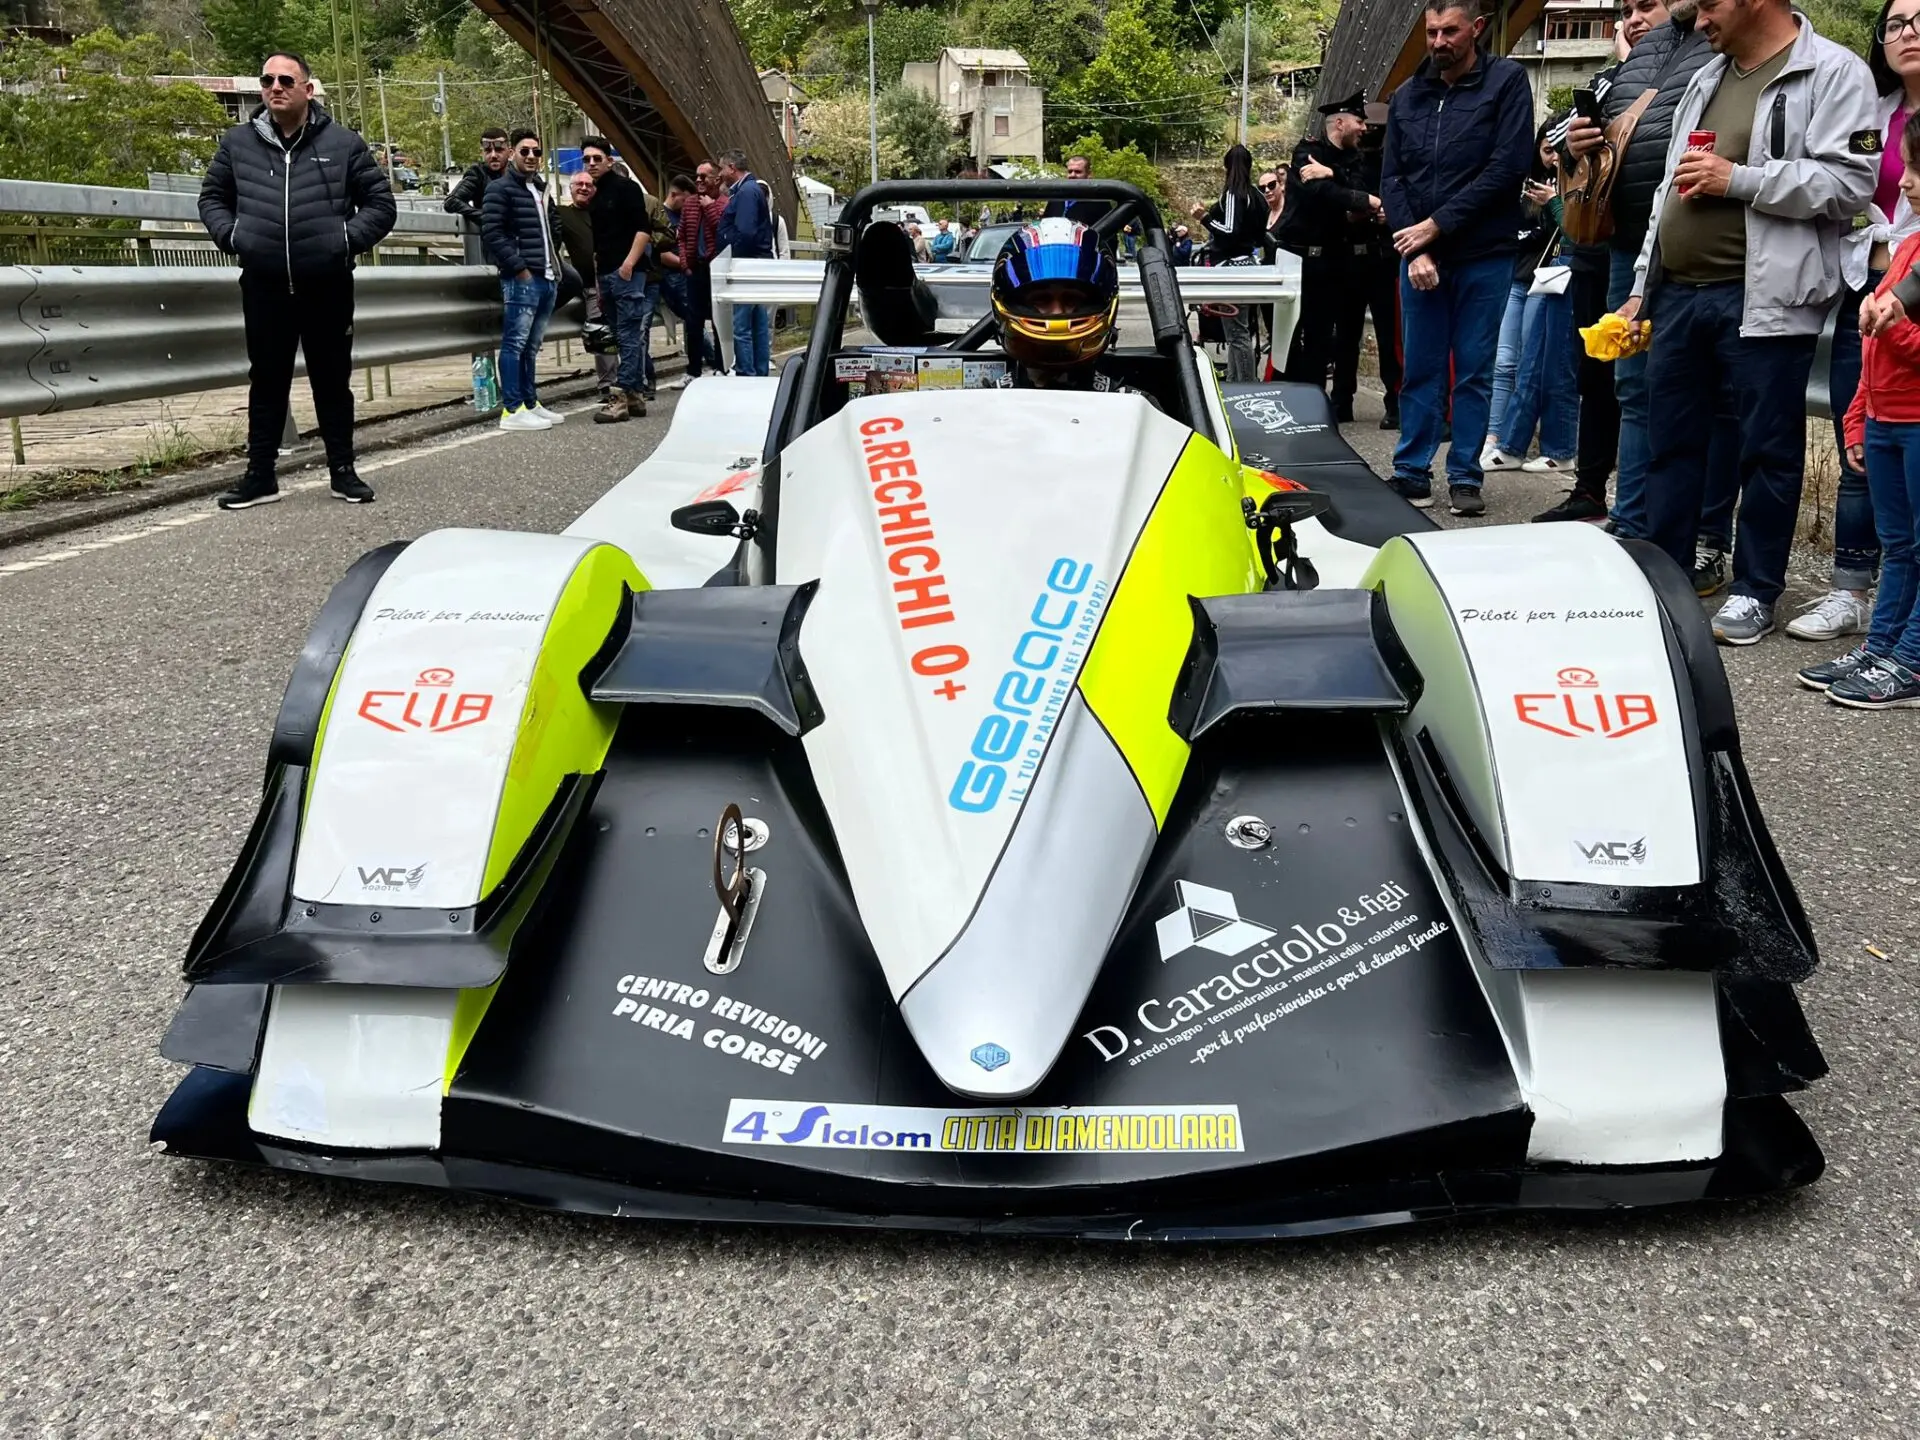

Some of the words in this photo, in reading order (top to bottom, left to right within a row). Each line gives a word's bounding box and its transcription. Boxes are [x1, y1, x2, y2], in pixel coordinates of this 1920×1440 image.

[860, 417, 955, 629] G.RECHICHI
[373, 608, 428, 621] Piloti
[430, 609, 462, 622] per
[464, 609, 545, 623] passione
[1460, 608, 1518, 623] Piloti
[1526, 610, 1557, 623] per
[1565, 608, 1645, 622] passione
[358, 691, 494, 732] ELIA
[1008, 786, 1026, 802] IL
[1017, 748, 1041, 779] TUO
[1033, 679, 1070, 743] PARTNER
[1062, 651, 1081, 677] NEI
[1072, 579, 1108, 647] TRASPORTI
[1514, 694, 1658, 738] ELIA
[358, 867, 406, 886] VAC
[1573, 840, 1629, 860] VAC
[1082, 1025, 1143, 1062] D.
[1137, 923, 1347, 1033] Caracciolo
[1337, 907, 1367, 927] &
[1359, 880, 1410, 915] figli
[1128, 1042, 1169, 1066] arredo
[1165, 1024, 1203, 1047] bagno
[1207, 980, 1288, 1025] termoidraulica
[1292, 953, 1341, 982] materiali
[1340, 942, 1364, 959] edili
[1368, 914, 1419, 945] colorificio
[1218, 1030, 1233, 1046] il
[1234, 985, 1327, 1044] professionista
[1326, 982, 1336, 991] e
[1336, 971, 1359, 990] per
[1356, 961, 1371, 975] il
[1370, 943, 1410, 969] cliente
[1408, 921, 1449, 951] finale
[612, 997, 696, 1041] PIRIA
[702, 1028, 802, 1075] CORSE
[616, 974, 710, 1009] CENTRO
[710, 995, 828, 1061] REVISIONI
[776, 1106, 932, 1148] Slalom
[1024, 1115, 1053, 1150] DI
[1056, 1114, 1237, 1150] AMENDOLARA
